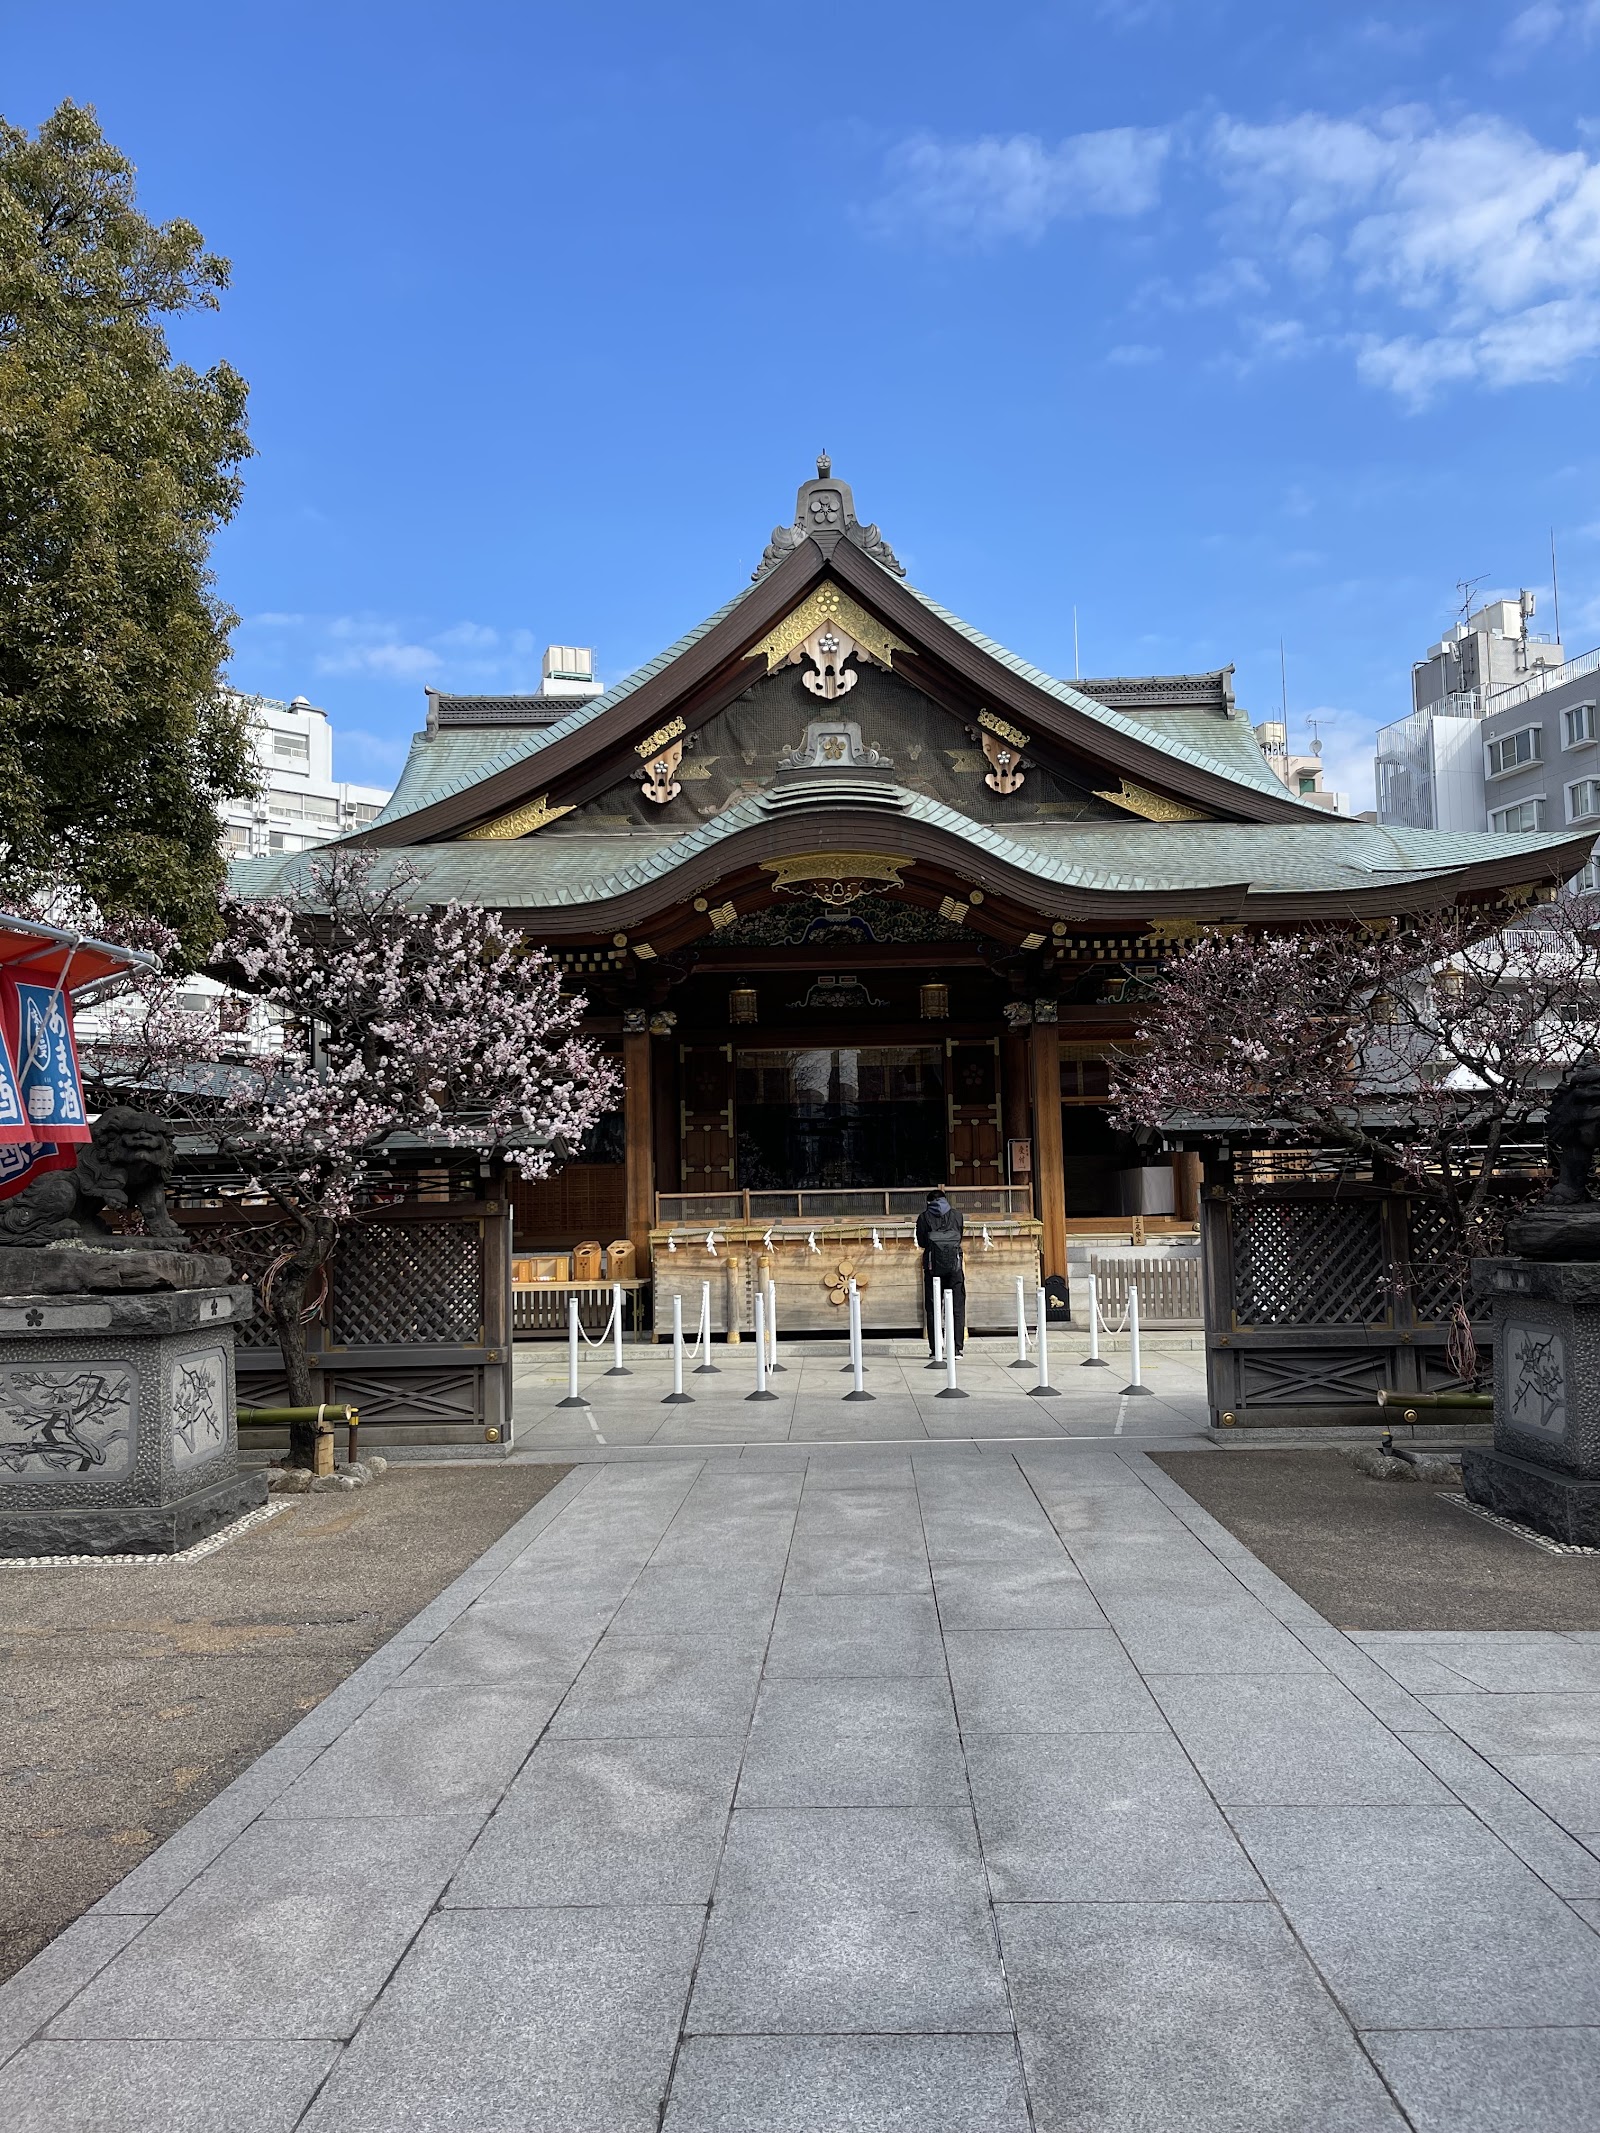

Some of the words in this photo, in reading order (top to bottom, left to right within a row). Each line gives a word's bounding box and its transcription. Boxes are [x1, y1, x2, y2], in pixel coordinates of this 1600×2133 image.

[46, 995, 80, 1120] あま酒
[1134, 1216, 1142, 1244] 土足禁止
